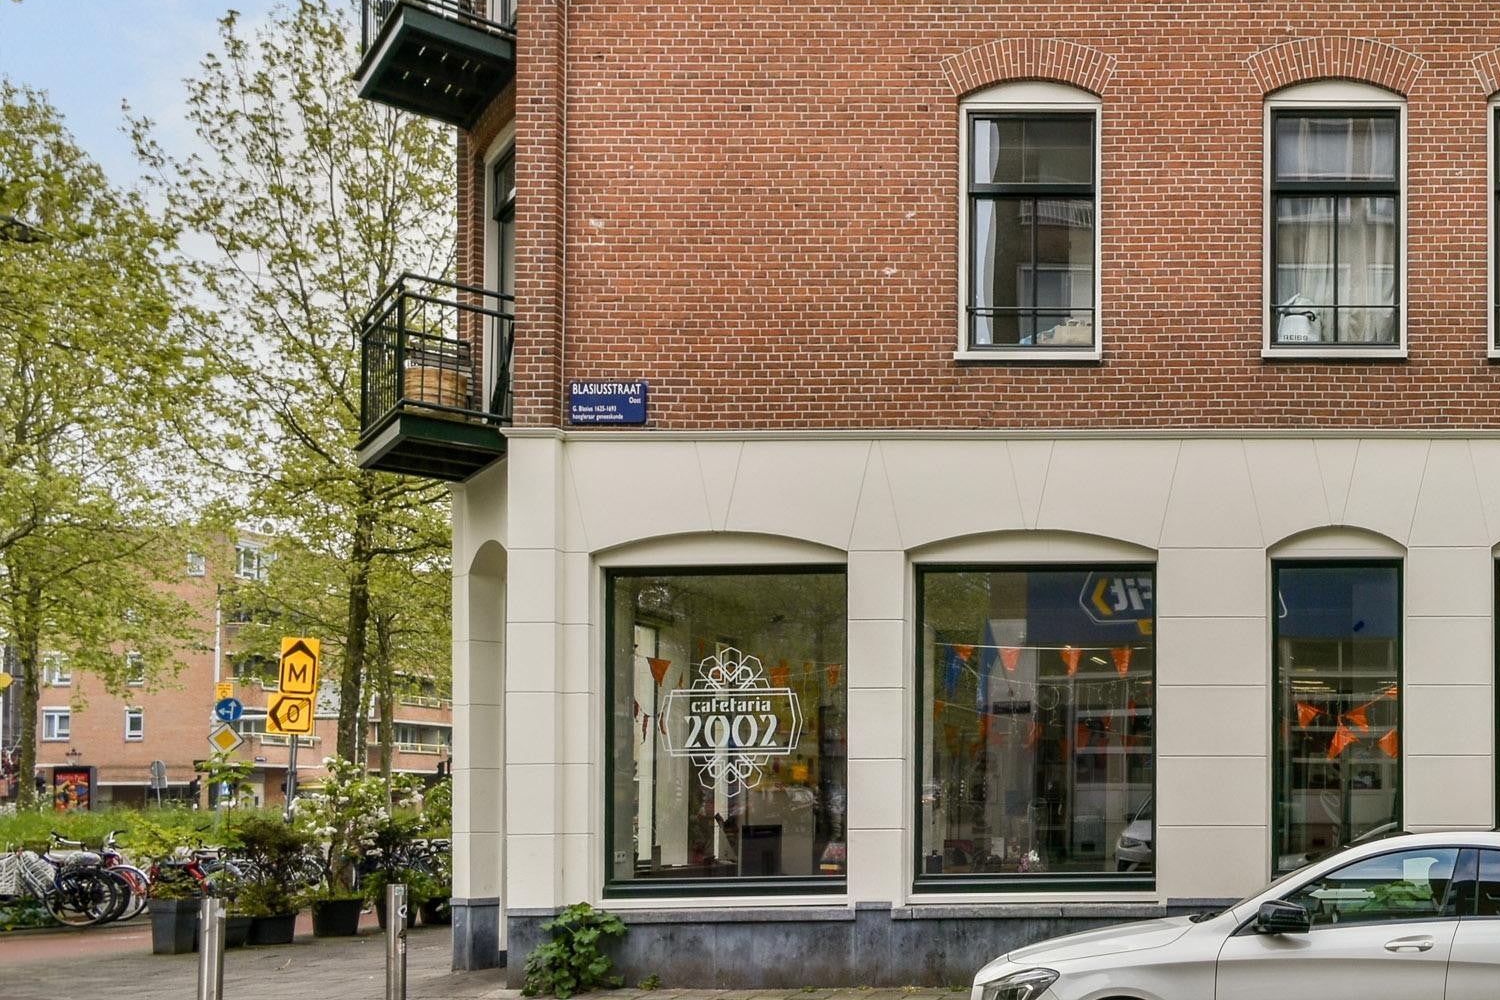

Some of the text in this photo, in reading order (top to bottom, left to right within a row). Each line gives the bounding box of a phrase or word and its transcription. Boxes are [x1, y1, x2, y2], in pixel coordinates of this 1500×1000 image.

[572, 383, 641, 395] BLASIUSSTRAAT
[628, 396, 641, 404] Oost
[288, 663, 307, 684] M
[691, 697, 771, 713] cafetaria
[684, 714, 778, 748] 2002
